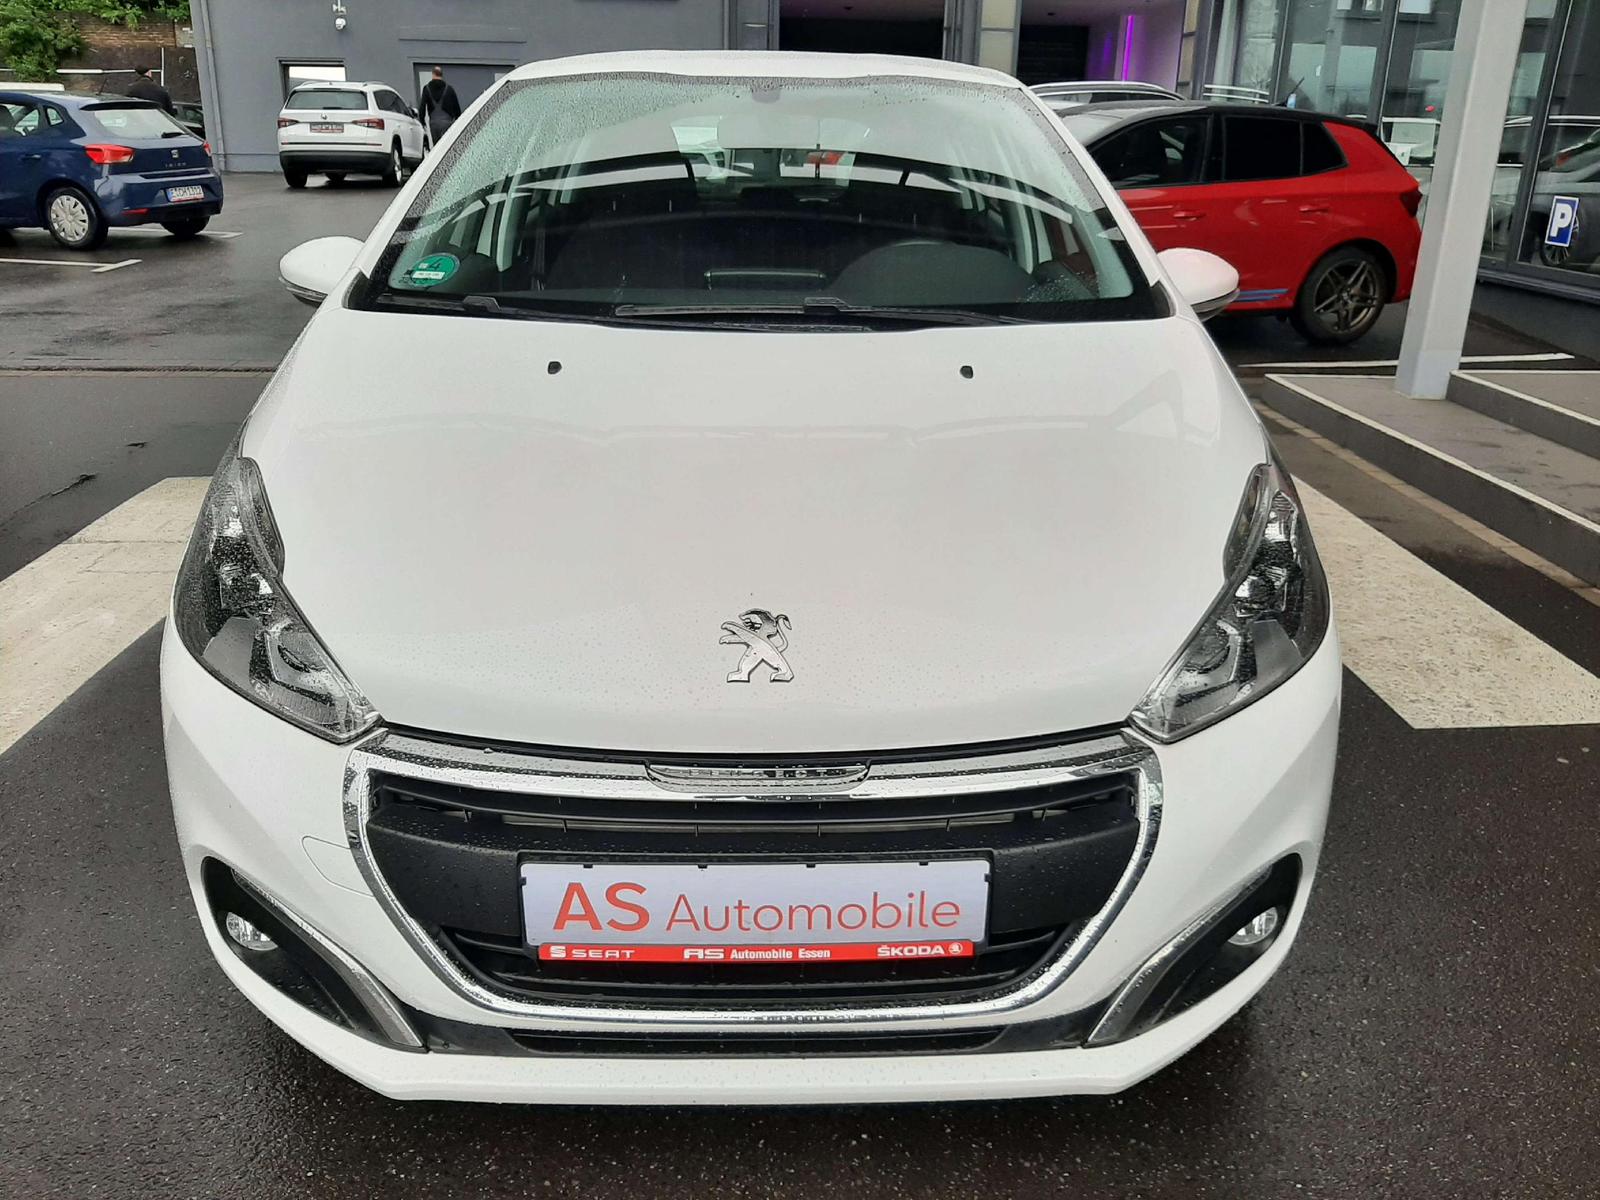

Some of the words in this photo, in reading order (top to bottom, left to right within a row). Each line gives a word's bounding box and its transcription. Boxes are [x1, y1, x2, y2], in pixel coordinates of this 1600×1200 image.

[1549, 203, 1573, 238] P
[552, 881, 650, 932] AS
[665, 890, 961, 932] Automobile
[571, 949, 635, 959] SEAT
[683, 948, 725, 960] AS
[729, 948, 793, 960] Automobile
[798, 947, 831, 959] Essen
[877, 944, 945, 958] ŠKODA
